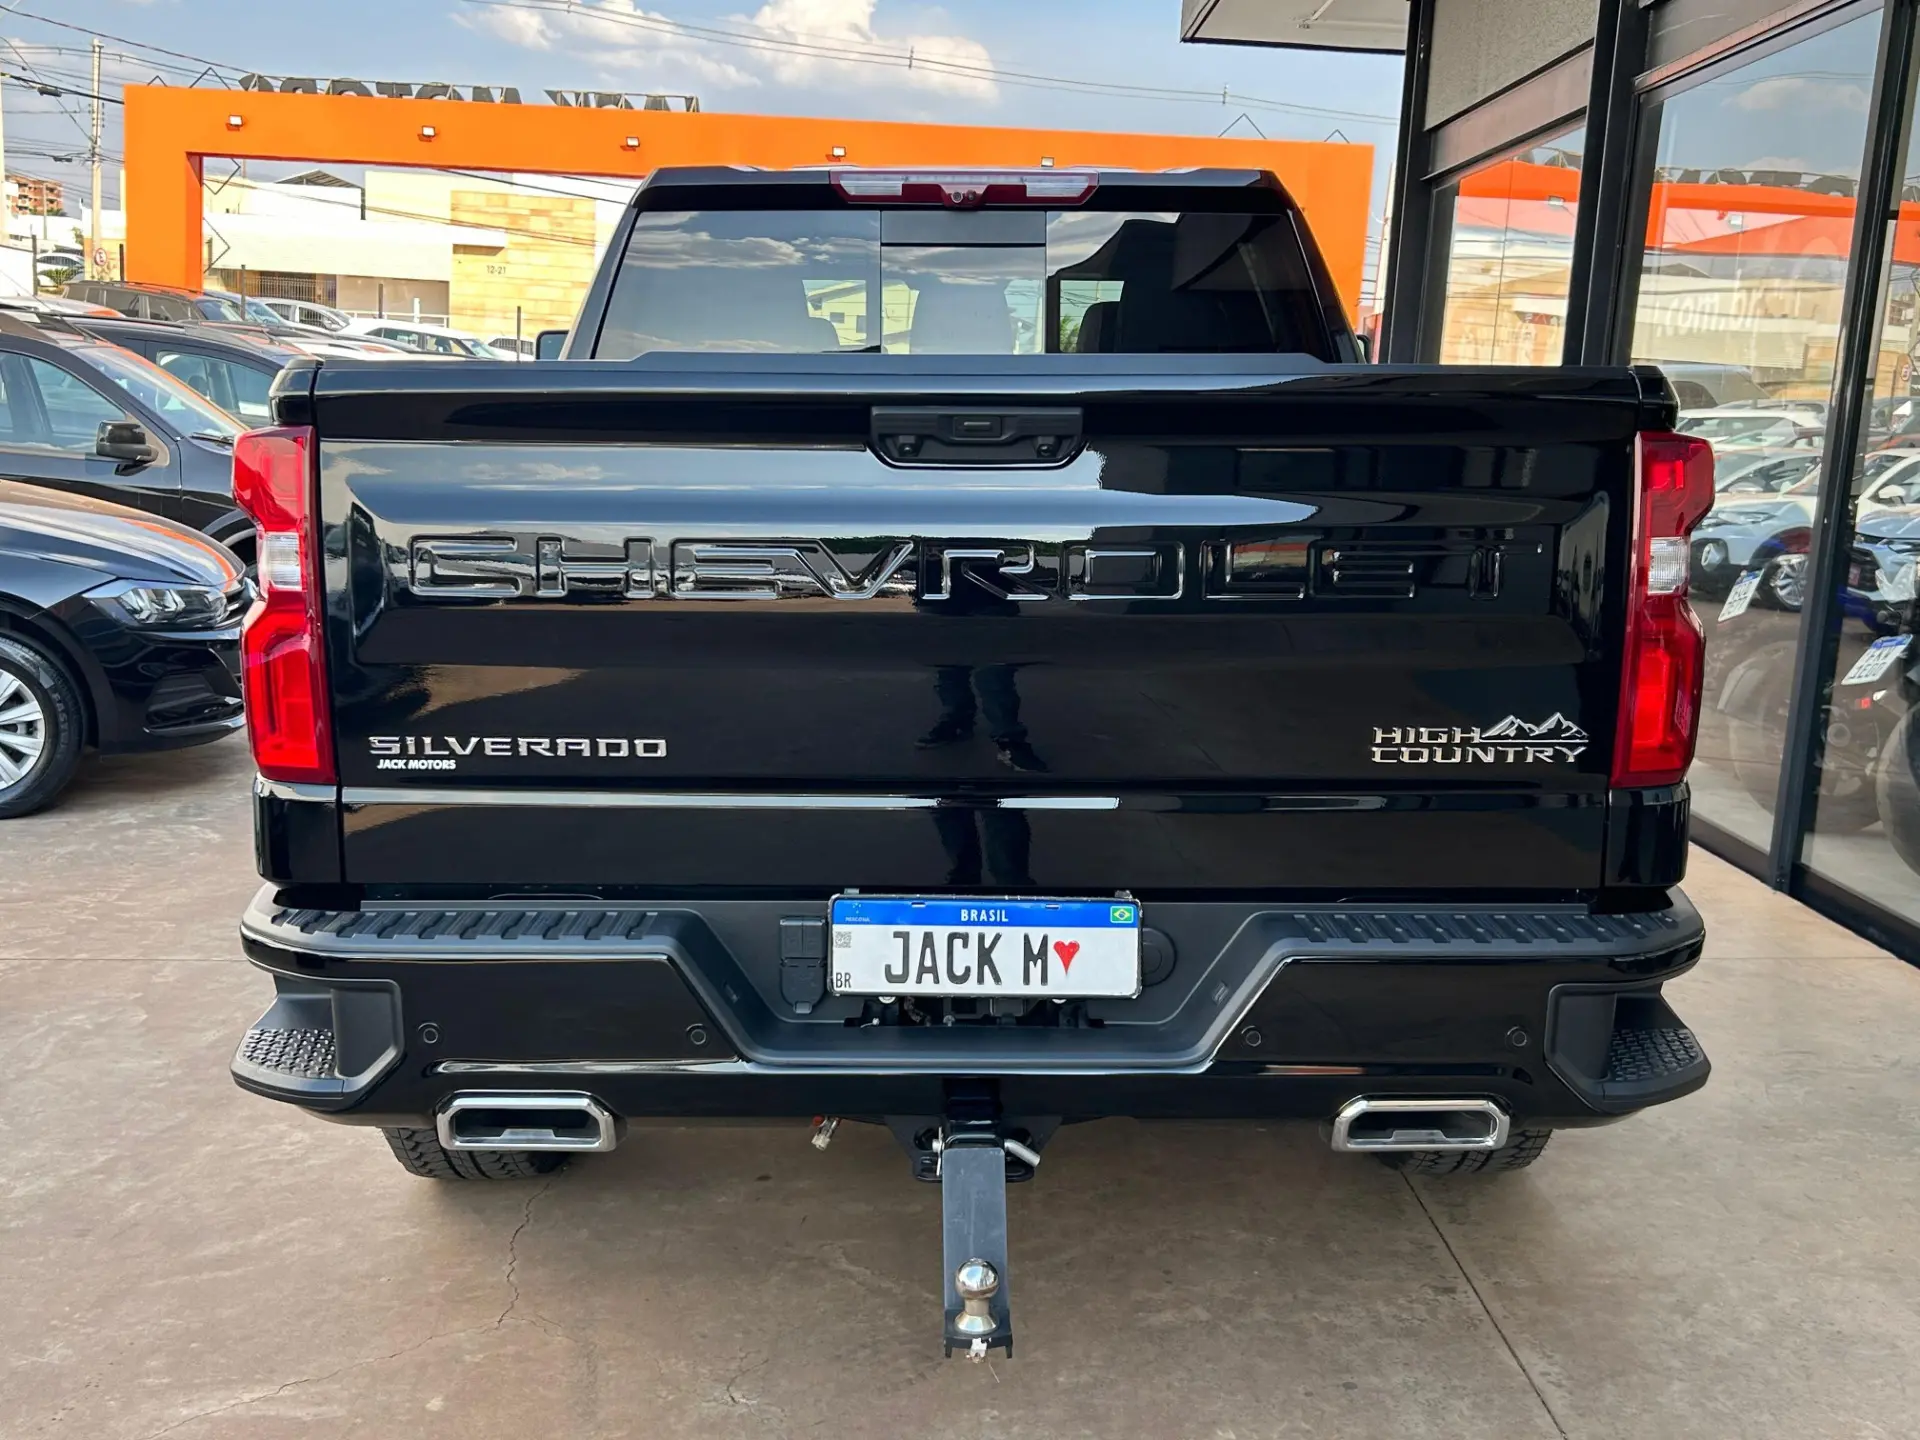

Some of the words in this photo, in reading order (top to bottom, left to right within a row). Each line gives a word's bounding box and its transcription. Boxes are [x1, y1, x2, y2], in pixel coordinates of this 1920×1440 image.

[408, 534, 1544, 601] CHEVROLET
[1372, 726, 1481, 745] HIGH
[368, 735, 667, 758] SILVERADO
[1371, 745, 1588, 764] COUNTRY
[377, 758, 406, 770] JACK
[407, 759, 456, 770] MOTORS
[960, 908, 1009, 922] BRASIL
[884, 931, 1002, 986] JACK
[835, 971, 852, 989] BR
